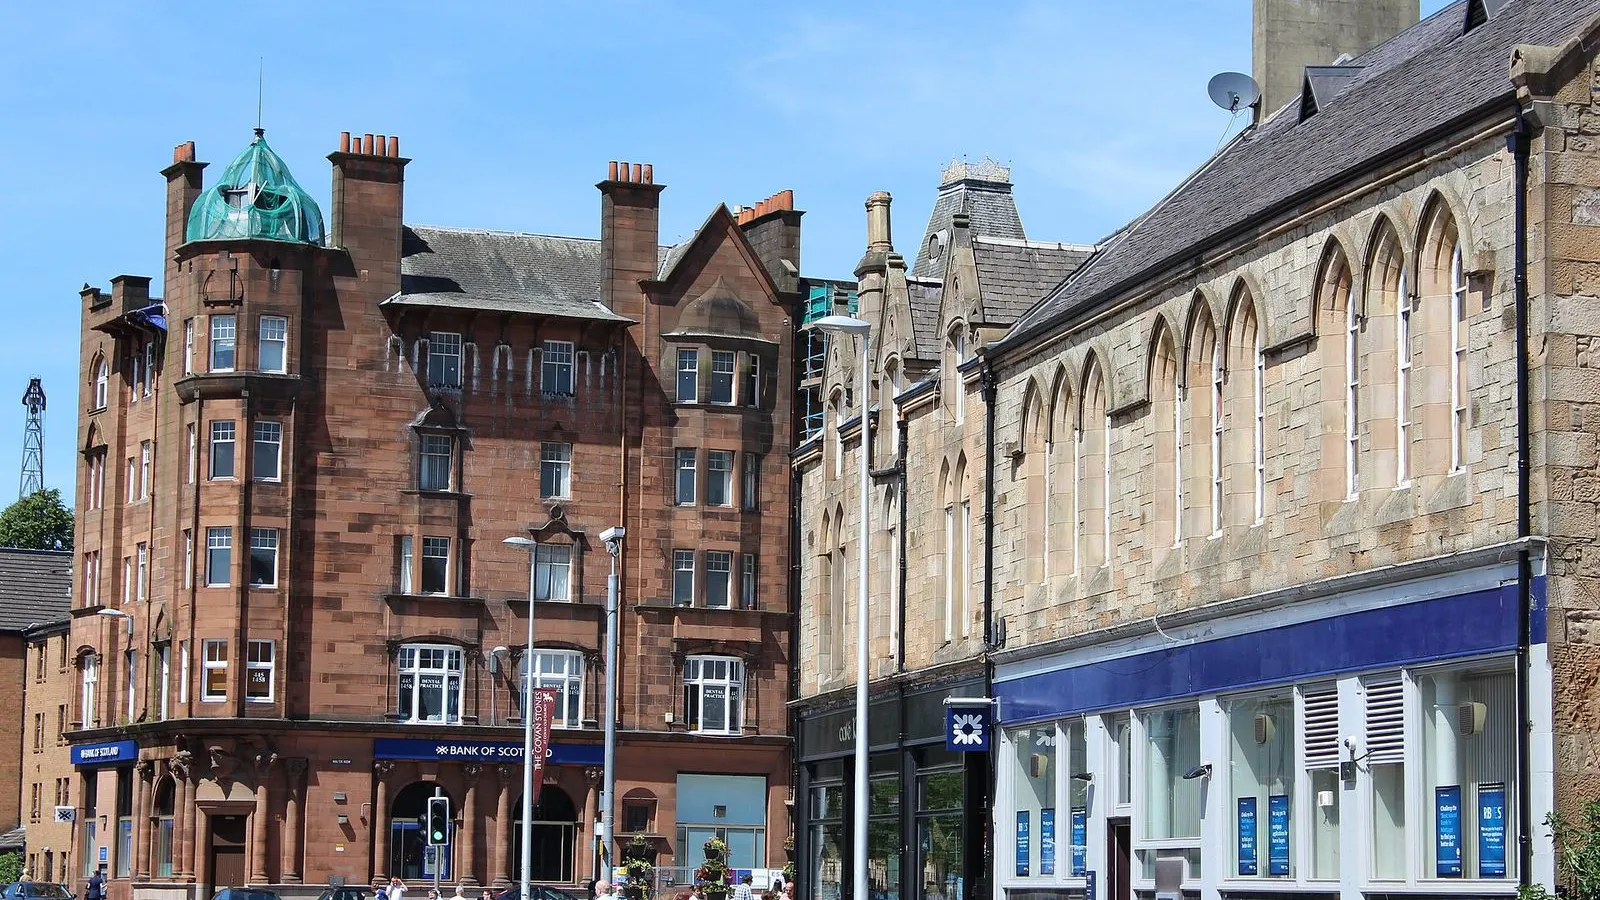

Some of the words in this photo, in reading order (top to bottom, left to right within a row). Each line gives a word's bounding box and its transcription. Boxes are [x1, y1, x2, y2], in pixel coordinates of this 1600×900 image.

[534, 723, 542, 753] GOVAN
[84, 749, 95, 758] BANK
[95, 748, 100, 757] OF
[100, 747, 119, 757] SCOTLAND
[450, 745, 478, 756] BANK
[480, 746, 496, 756] OF
[498, 747, 553, 757] SCOTD
[534, 754, 542, 771] THE
